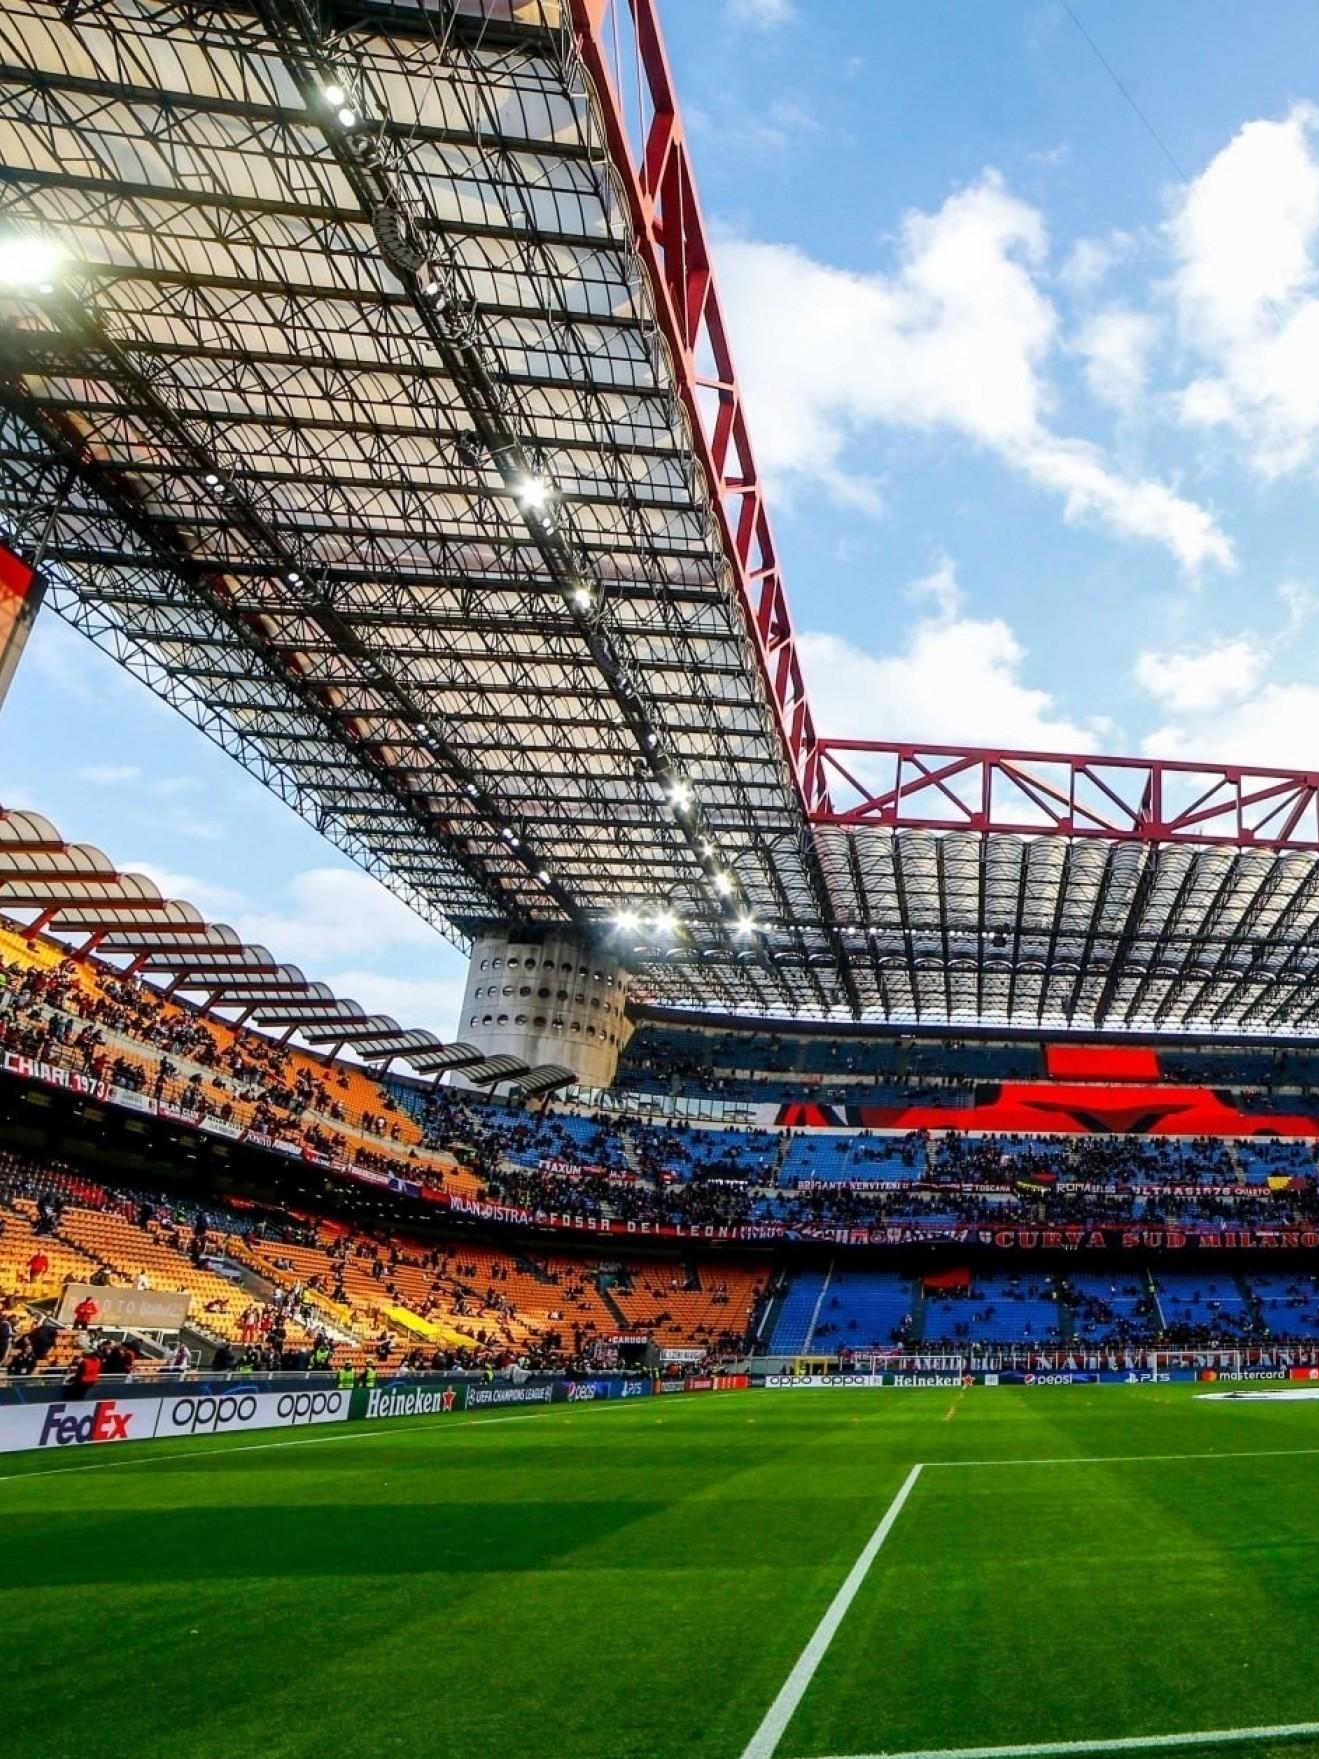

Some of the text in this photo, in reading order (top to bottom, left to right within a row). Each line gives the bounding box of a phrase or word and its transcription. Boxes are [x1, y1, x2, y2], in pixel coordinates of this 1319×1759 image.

[73, 1074, 104, 1098] 1973
[1056, 1183, 1091, 1193] ROMA
[549, 1212, 611, 1232] FOSSA
[627, 1220, 660, 1234] DEI
[676, 1224, 738, 1238] LEONI
[995, 1231, 1107, 1248] CURVA
[1122, 1231, 1187, 1248] SUD
[770, 1375, 812, 1388] oppo
[820, 1375, 865, 1388] oppo
[895, 1375, 962, 1387] Heineken
[1037, 1373, 1073, 1385] pepsi
[1140, 1373, 1171, 1383] PS5
[1219, 1369, 1285, 1381] mastercard
[365, 1386, 441, 1419] Heineken
[476, 1387, 546, 1404] UEFA CHAMPIONS LEAGUE
[172, 1396, 258, 1433] oppo
[277, 1391, 343, 1424] oppo
[39, 1401, 133, 1446] FedEx
